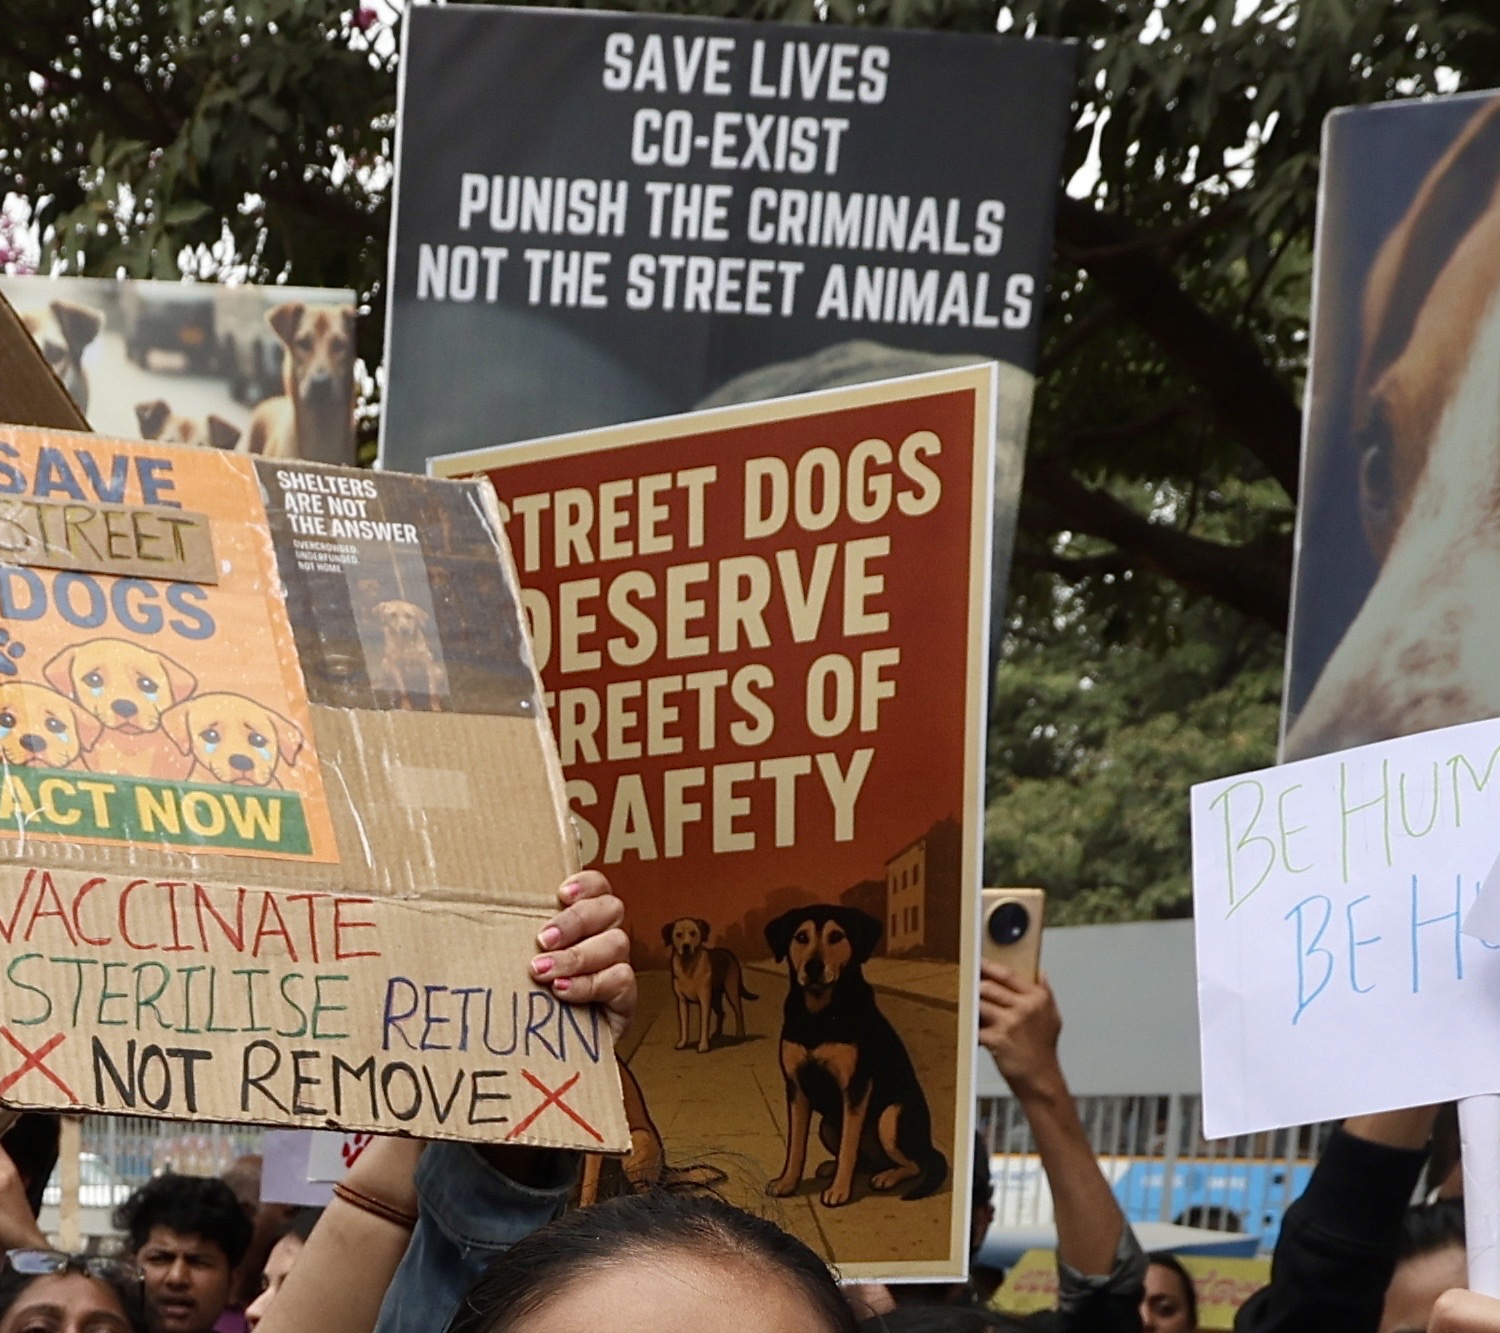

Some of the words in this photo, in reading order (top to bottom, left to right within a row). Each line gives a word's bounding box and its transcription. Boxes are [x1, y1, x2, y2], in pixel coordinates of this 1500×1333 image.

[602, 33, 737, 97] SAVE
[749, 41, 891, 105] LIVES
[630, 108, 850, 176] CO-EXIST
[457, 174, 628, 239] PUNISH
[645, 181, 732, 243] THE
[746, 190, 1006, 257] CRIMINALS
[415, 243, 509, 303] NOT
[522, 247, 609, 310] THE
[625, 254, 804, 319] STREET
[816, 265, 1035, 331] ANIMALS
[276, 470, 378, 499] SHELTERS
[284, 491, 325, 515] ARE
[327, 497, 368, 519] NOT
[287, 513, 327, 537] THE
[331, 518, 419, 544] ANSWER
[742, 430, 945, 542] DOGS
[543, 663, 776, 770] REETS
[805, 648, 901, 739] OF
[134, 787, 282, 850] NOW
[566, 748, 876, 868] SAFETY
[1209, 779, 1314, 919] BE
[1284, 893, 1382, 1025] BE
[6, 952, 350, 1039] STERILISE
[382, 977, 601, 1064] RETURN
[90, 1037, 212, 1116] NOT
[241, 1039, 509, 1126] REMOVE
